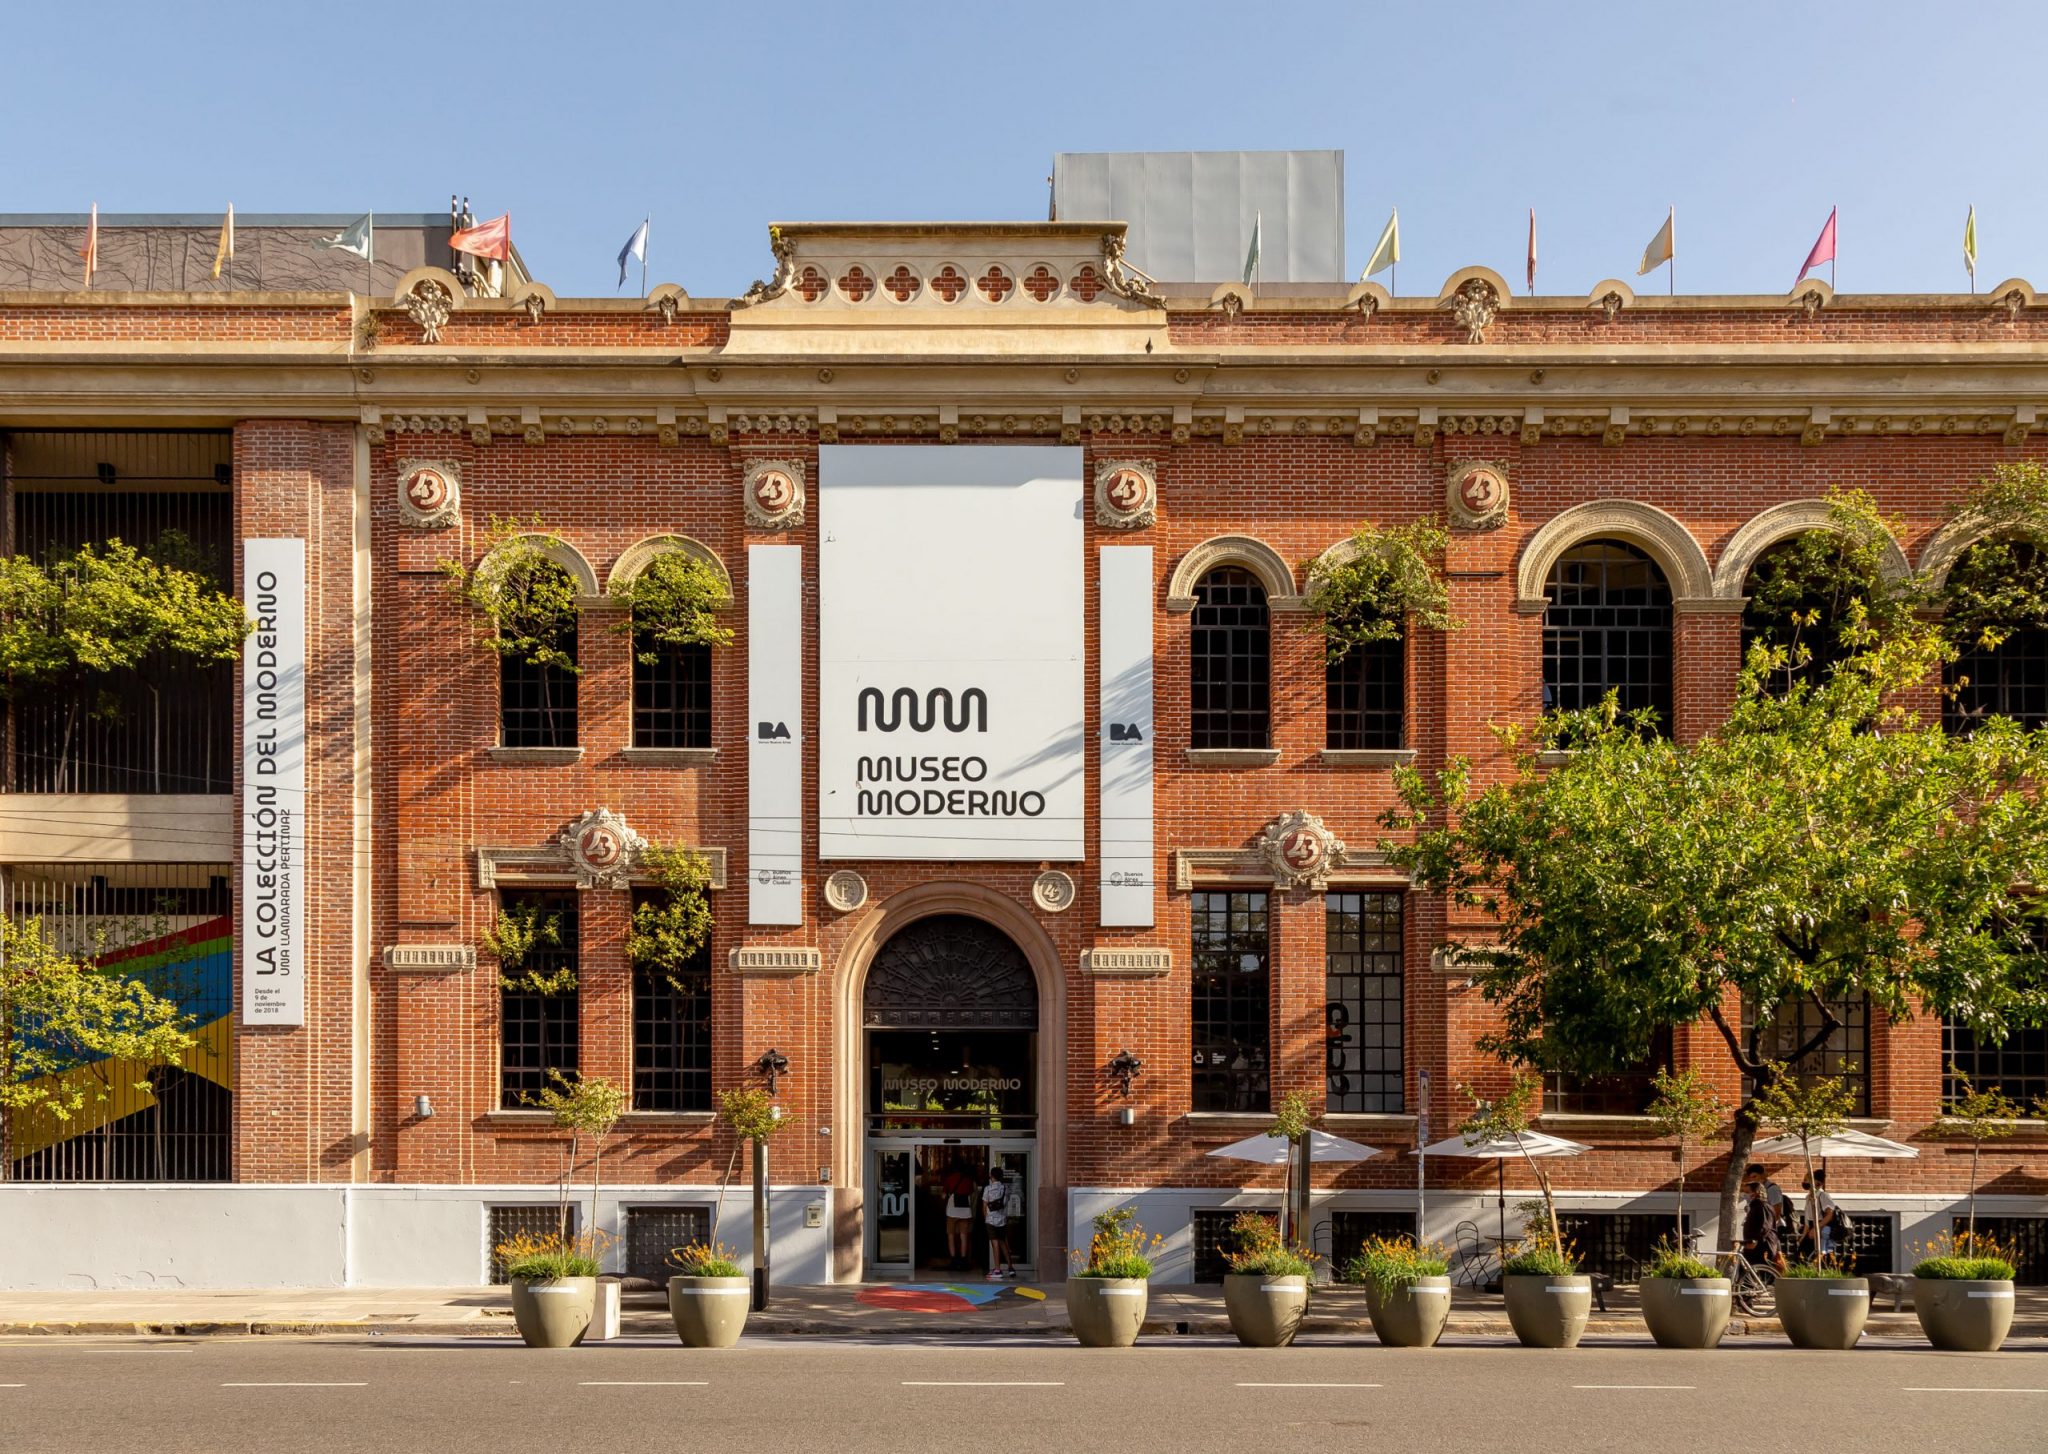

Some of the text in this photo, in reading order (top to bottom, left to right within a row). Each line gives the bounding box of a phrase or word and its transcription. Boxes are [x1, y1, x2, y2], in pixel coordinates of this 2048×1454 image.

[758, 721, 791, 740] BA
[1110, 723, 1143, 741] BA
[251, 571, 277, 976] LA COLECCIÓN DEL MODERNO
[857, 756, 988, 783] MUSEO
[857, 789, 1046, 817] MODERNO
[280, 808, 291, 976] UNA LLAMARADA PERTINAZ
[884, 1078, 1021, 1090] MUSEO MODERNO
